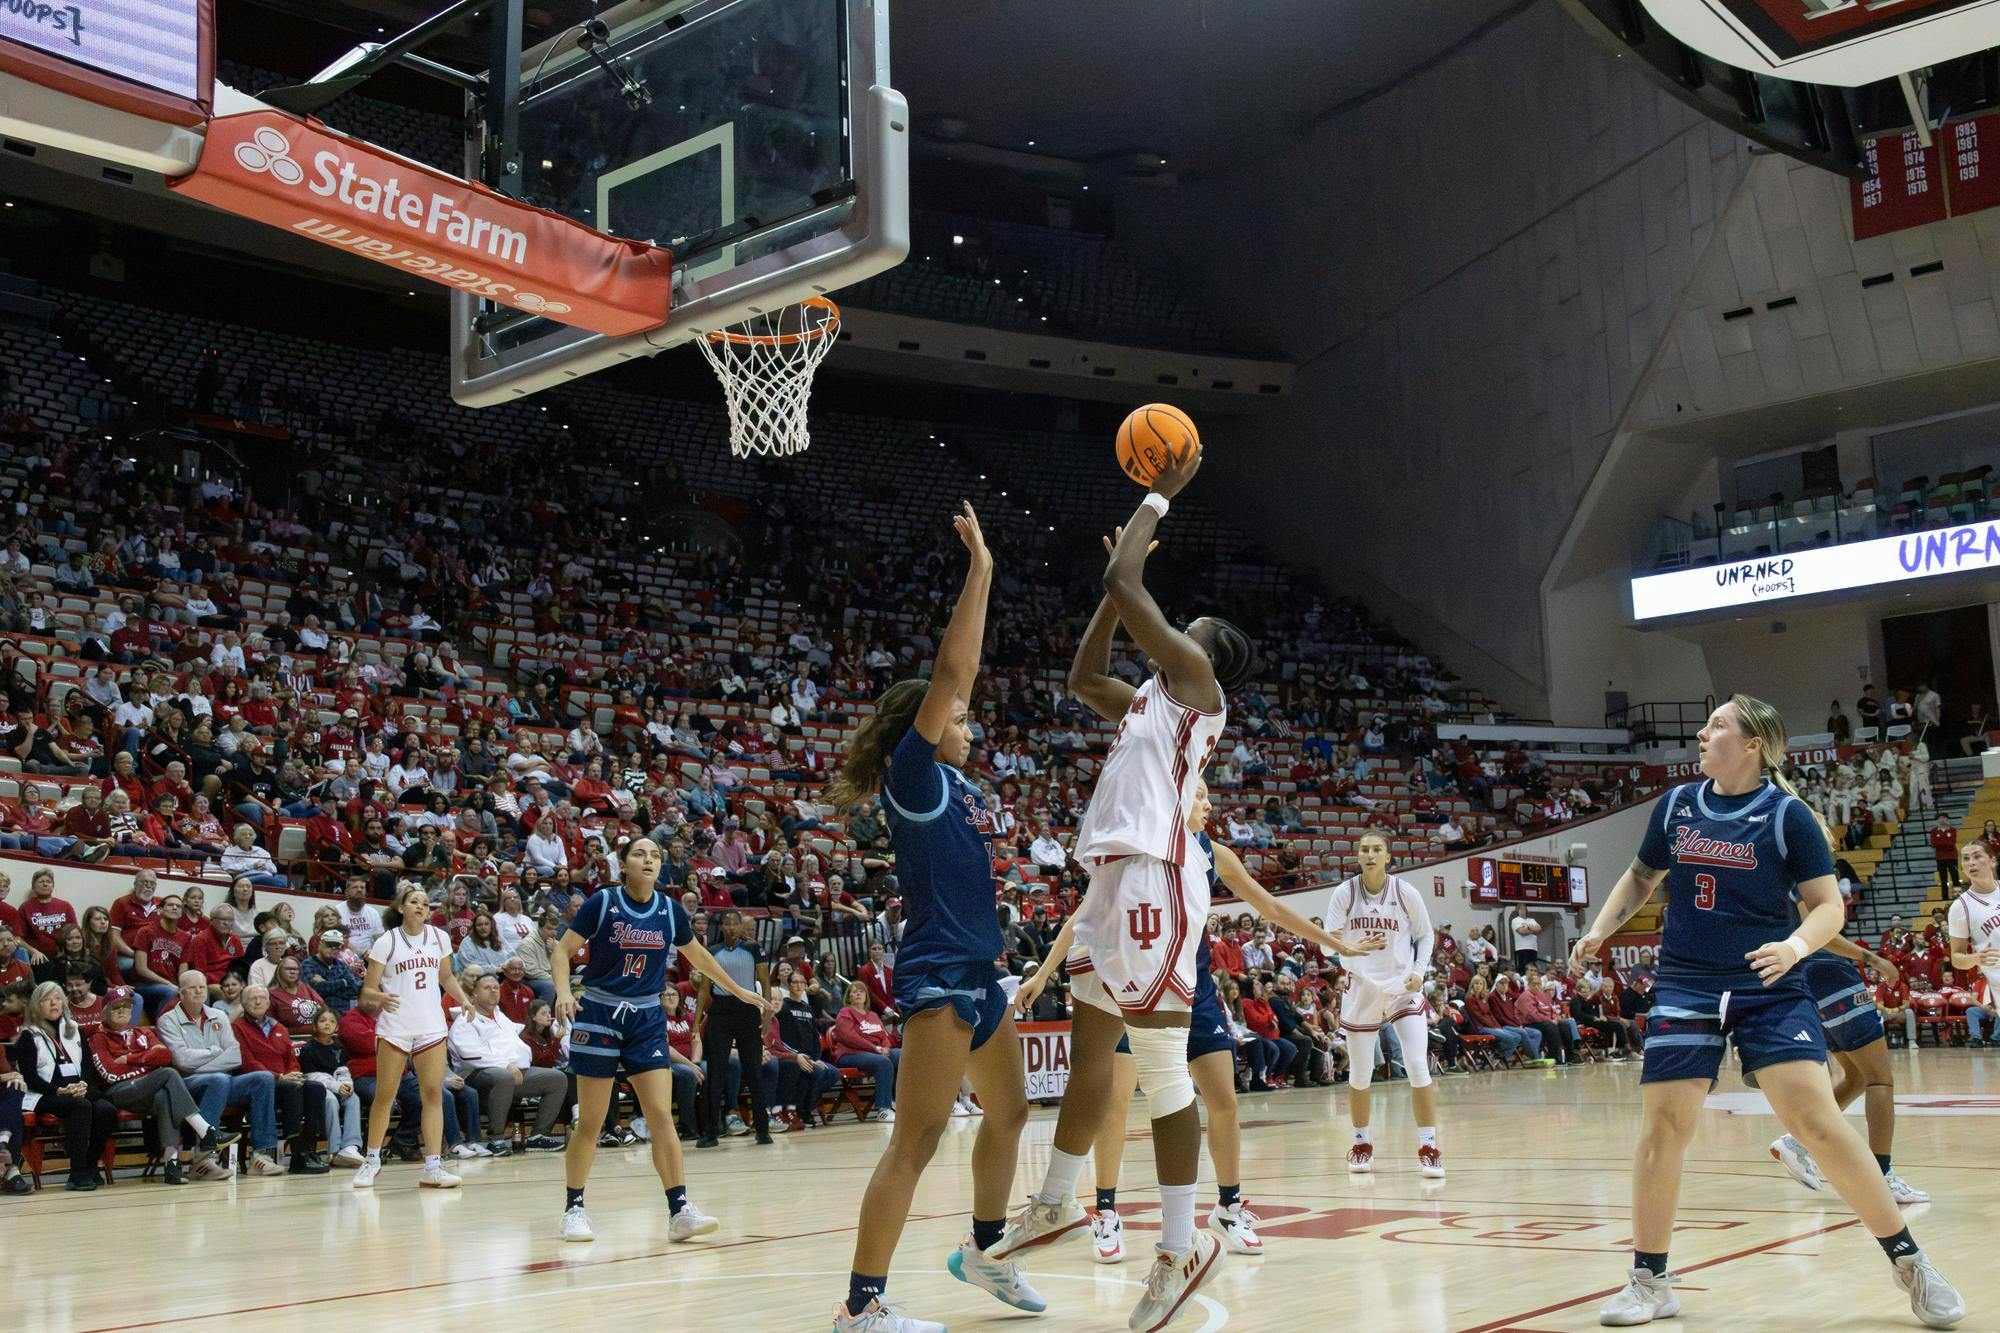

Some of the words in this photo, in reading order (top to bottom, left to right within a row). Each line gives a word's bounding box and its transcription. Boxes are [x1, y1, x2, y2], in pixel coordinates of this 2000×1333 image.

[0, 0, 85, 46] OOPS}
[1957, 135, 1978, 151] 1987
[1904, 151, 1925, 166] 1974
[1906, 166, 1926, 182] 1975
[1959, 165, 1979, 182] 1991
[1716, 559, 1794, 586] UNRNKD
[1671, 826, 1755, 862] Flames
[1695, 873, 1716, 910] 3
[608, 922, 665, 944] Flames
[1350, 917, 1399, 932] INDIANA
[395, 957, 439, 975] INDIANA
[623, 954, 647, 979] 14
[414, 972, 427, 990] 2
